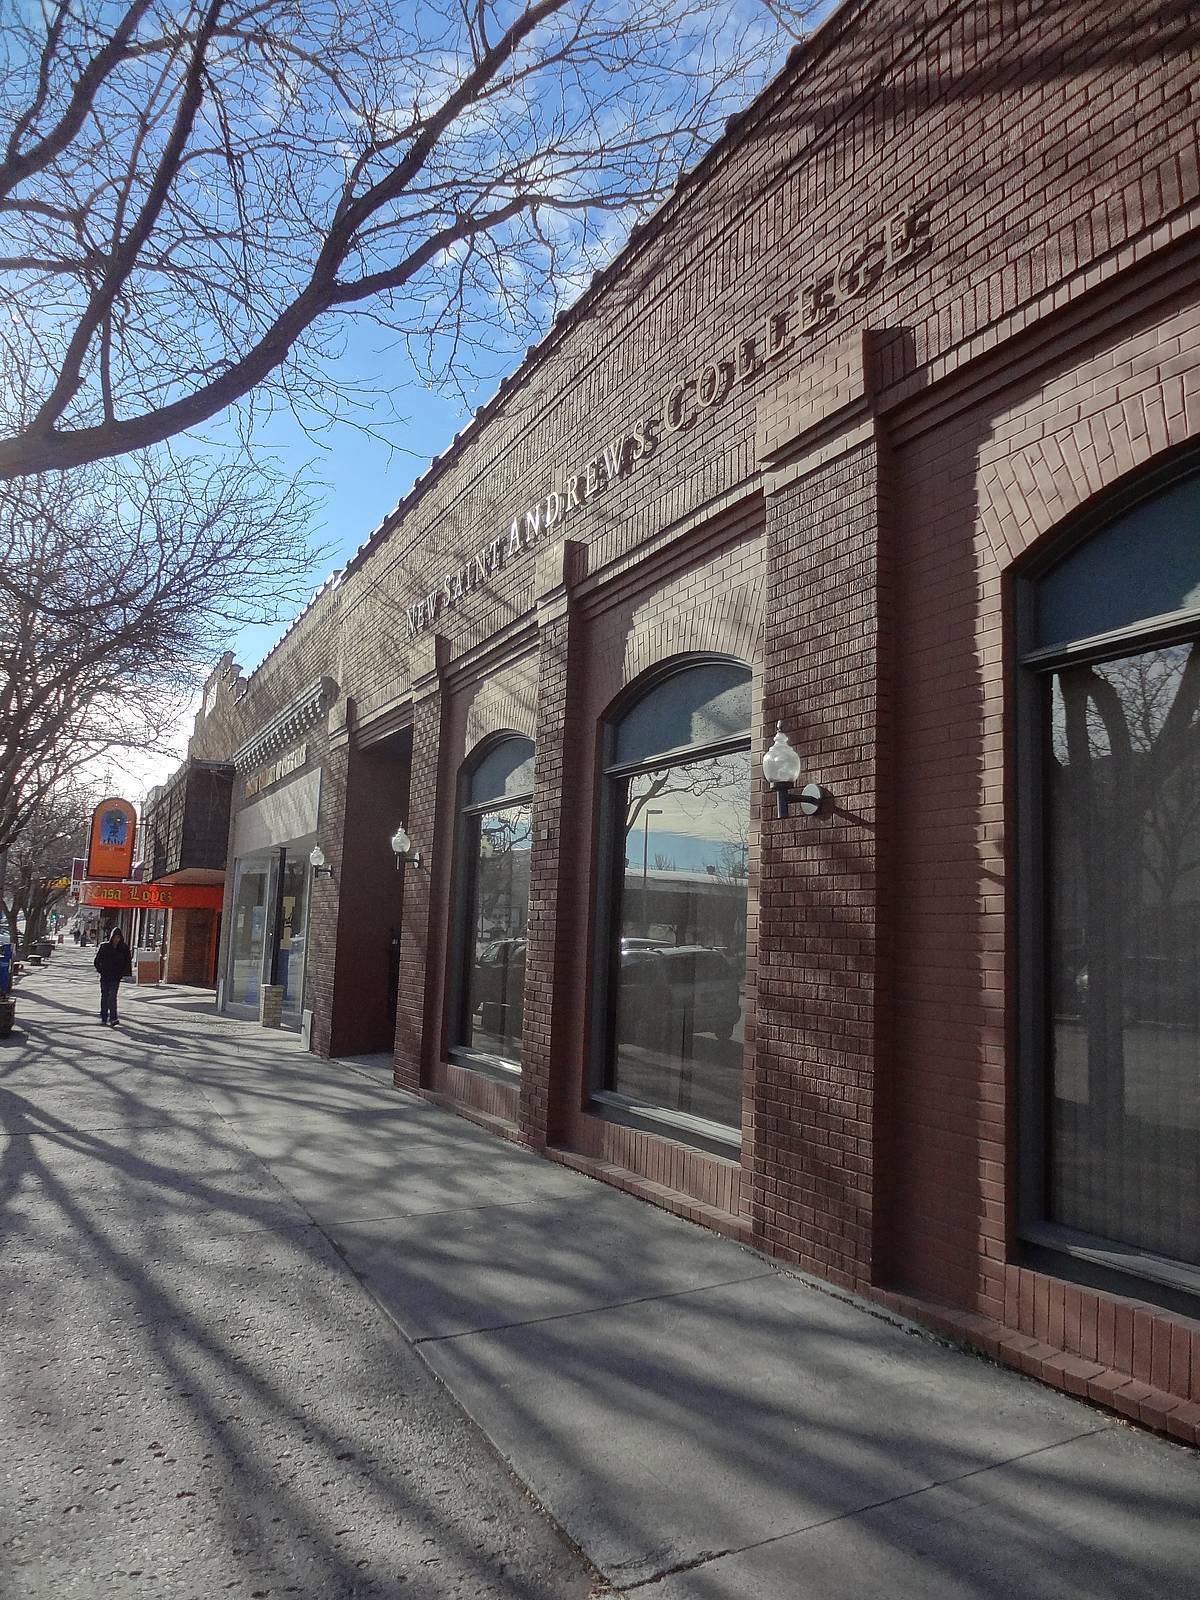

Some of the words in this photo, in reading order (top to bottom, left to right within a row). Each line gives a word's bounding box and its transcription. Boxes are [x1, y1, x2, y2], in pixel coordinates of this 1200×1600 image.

[404, 590, 438, 637] NEW
[442, 538, 500, 607] SAINT
[508, 419, 645, 556] ANDREWS
[663, 207, 918, 433] COLLEGE
[89, 884, 122, 900] Casa
